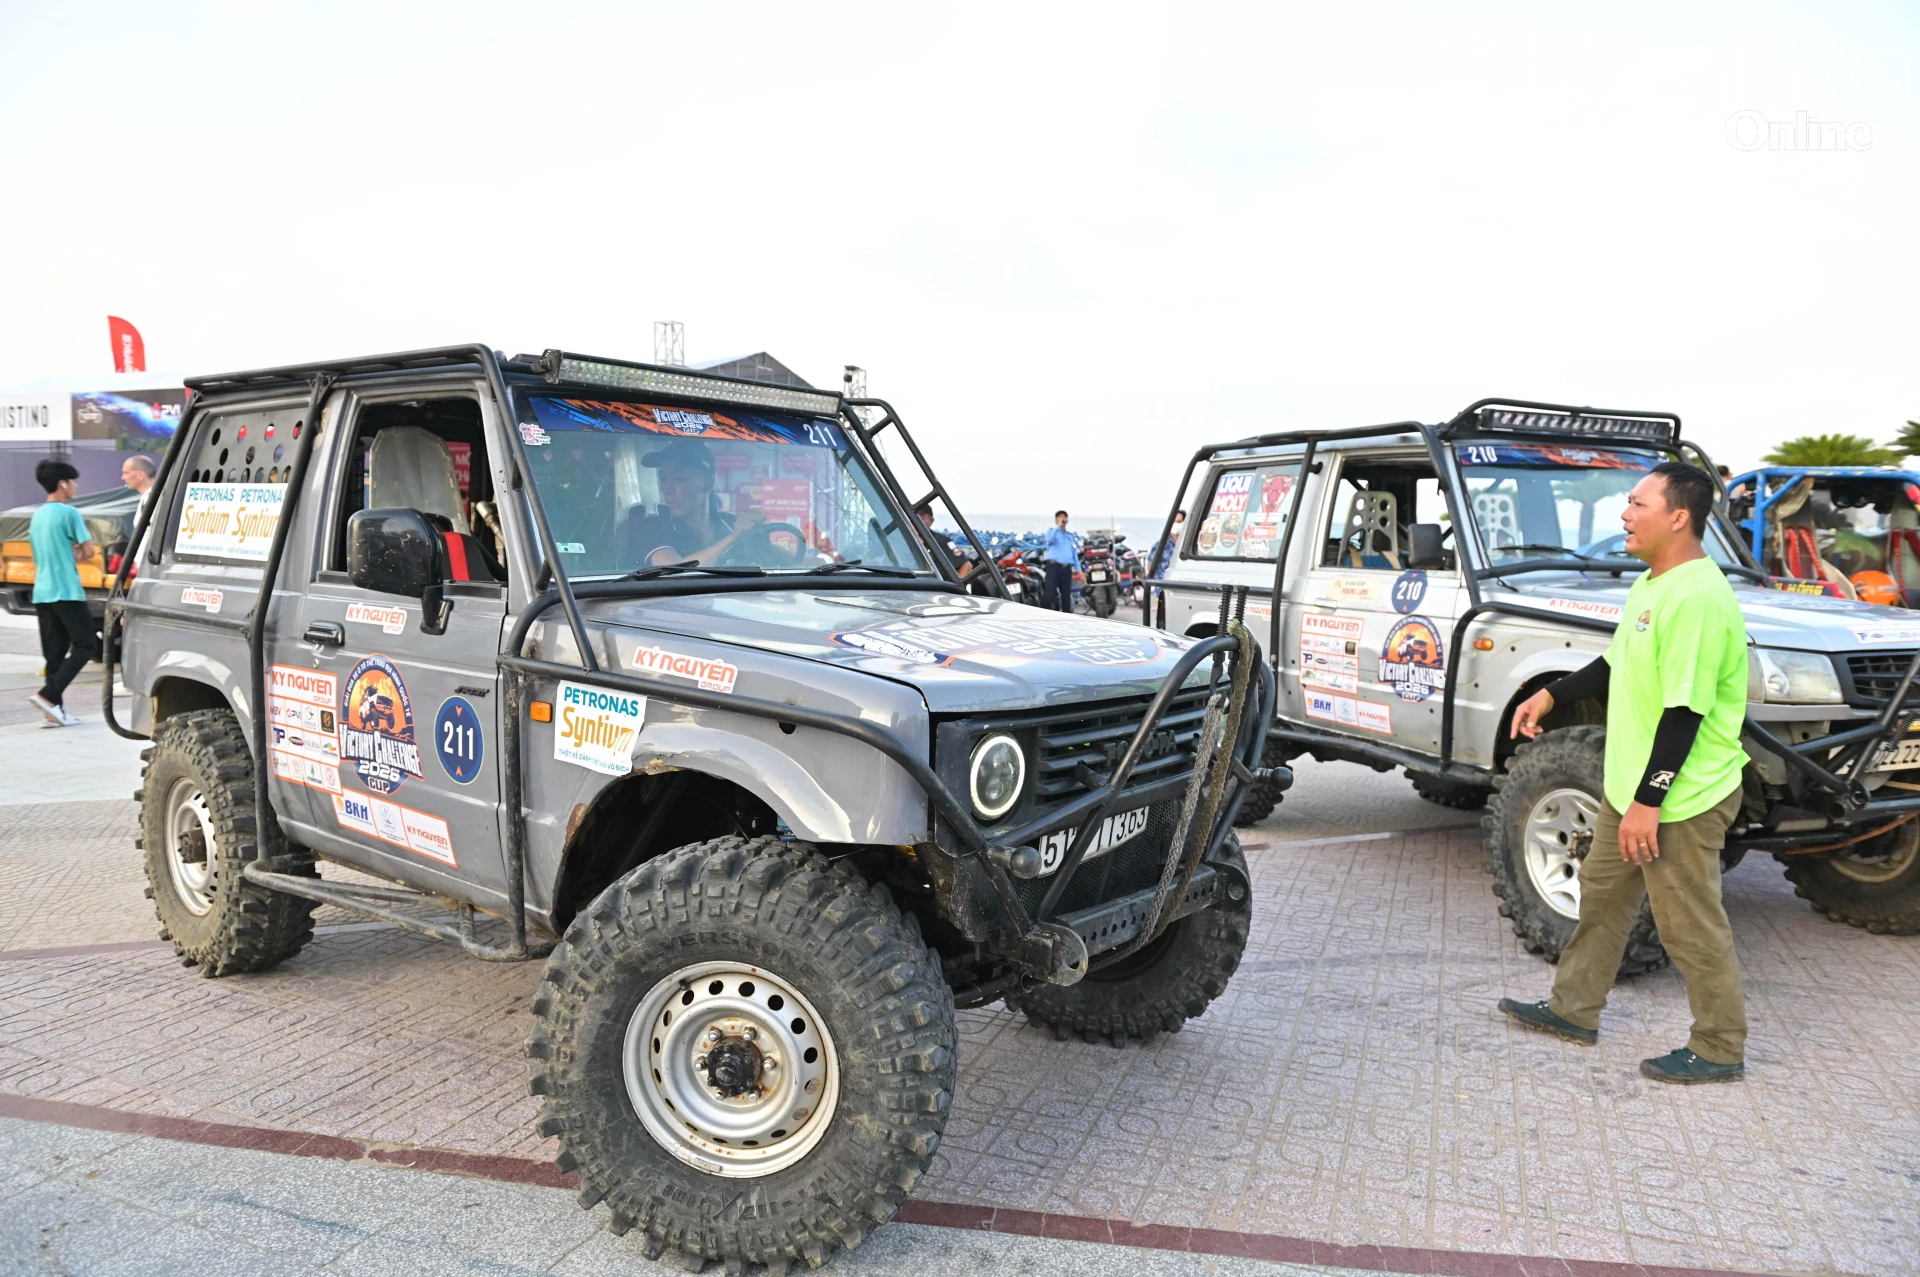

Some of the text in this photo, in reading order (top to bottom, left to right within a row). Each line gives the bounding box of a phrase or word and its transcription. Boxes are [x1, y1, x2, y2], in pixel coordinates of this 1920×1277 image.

[0, 405, 49, 428] ISTINO
[802, 423, 838, 446] 211
[1468, 446, 1498, 463] 210
[1219, 475, 1253, 493] LIQUI
[188, 487, 284, 503] PETRONAS PETRONA
[1213, 494, 1248, 511] MOLY
[181, 504, 230, 539] Syntium
[1396, 580, 1423, 600] 210
[700, 681, 731, 692] GROUP
[1395, 681, 1430, 695] 2026
[564, 686, 640, 717] PETRONAS
[561, 706, 635, 754] Syntium
[443, 721, 474, 760] 211
[358, 760, 400, 783] 2026
[368, 777, 390, 793] CUP
